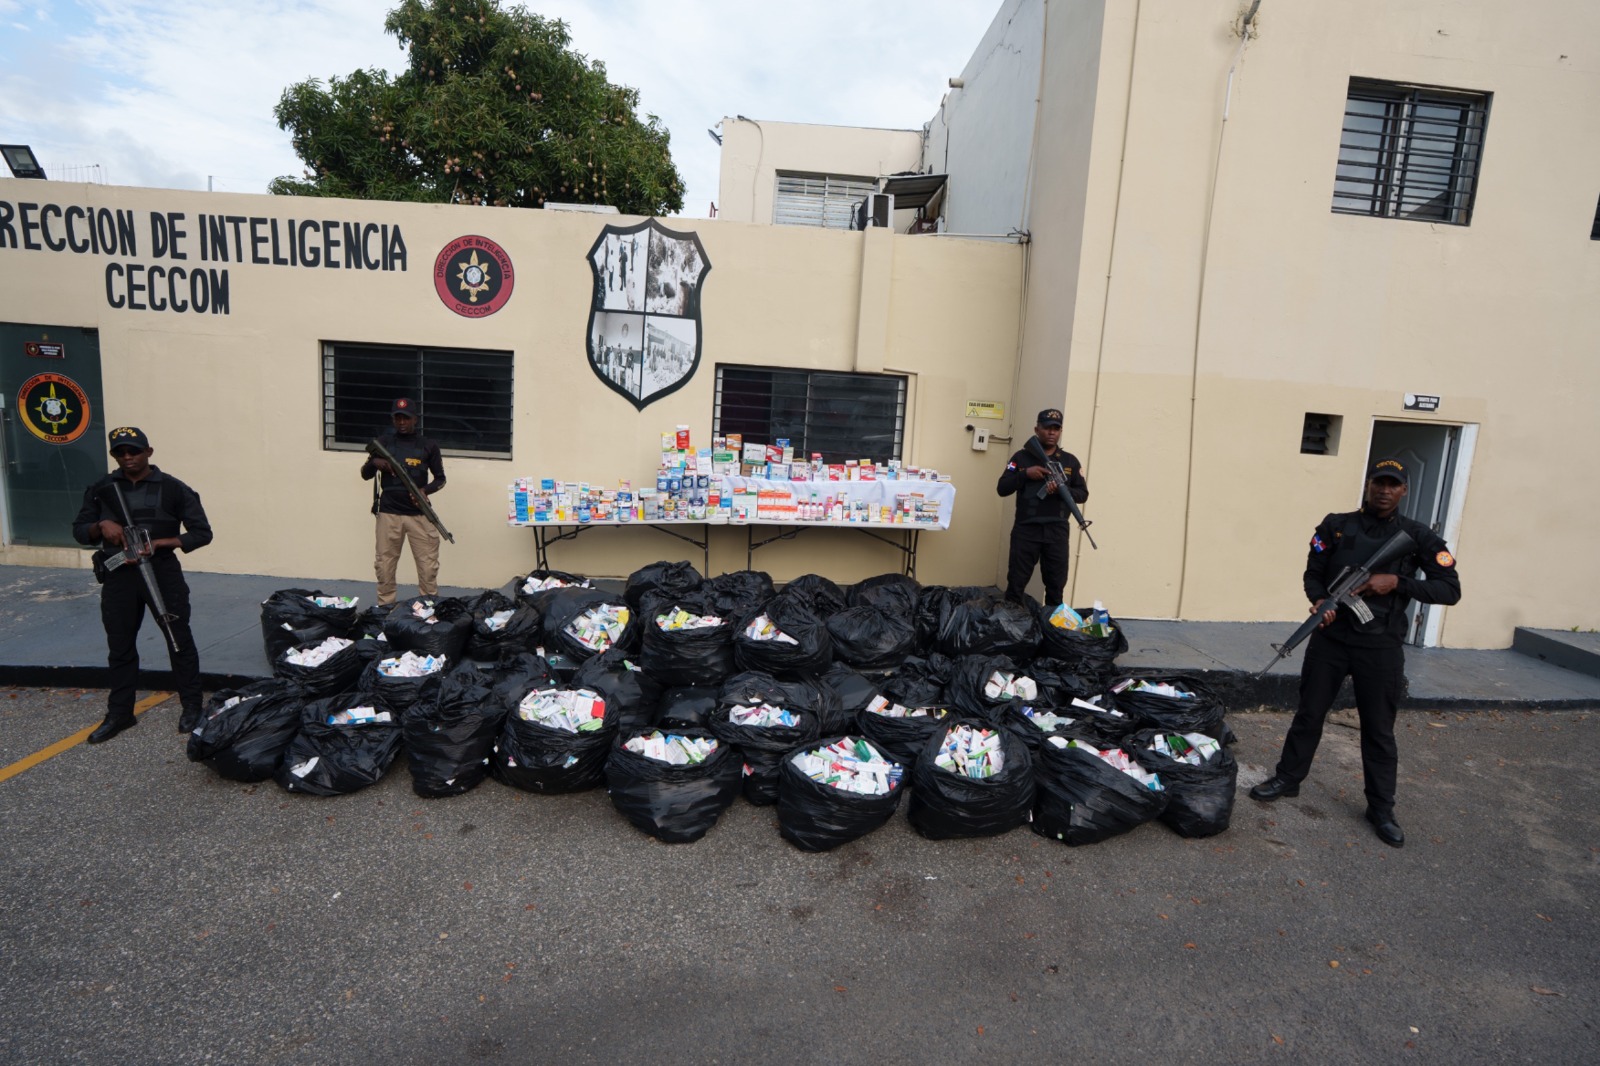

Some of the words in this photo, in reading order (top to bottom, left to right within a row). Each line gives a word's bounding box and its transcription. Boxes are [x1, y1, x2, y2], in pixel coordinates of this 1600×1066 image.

[0, 200, 137, 257] RECCION
[150, 211, 188, 260] DE
[199, 213, 407, 271] INTELIGENCIA
[437, 242, 461, 278] DIRECCION
[463, 239, 473, 247] DE
[475, 239, 511, 280] INTELIGENCIA
[105, 262, 230, 315] CECCOM
[455, 303, 492, 315] CECCOM
